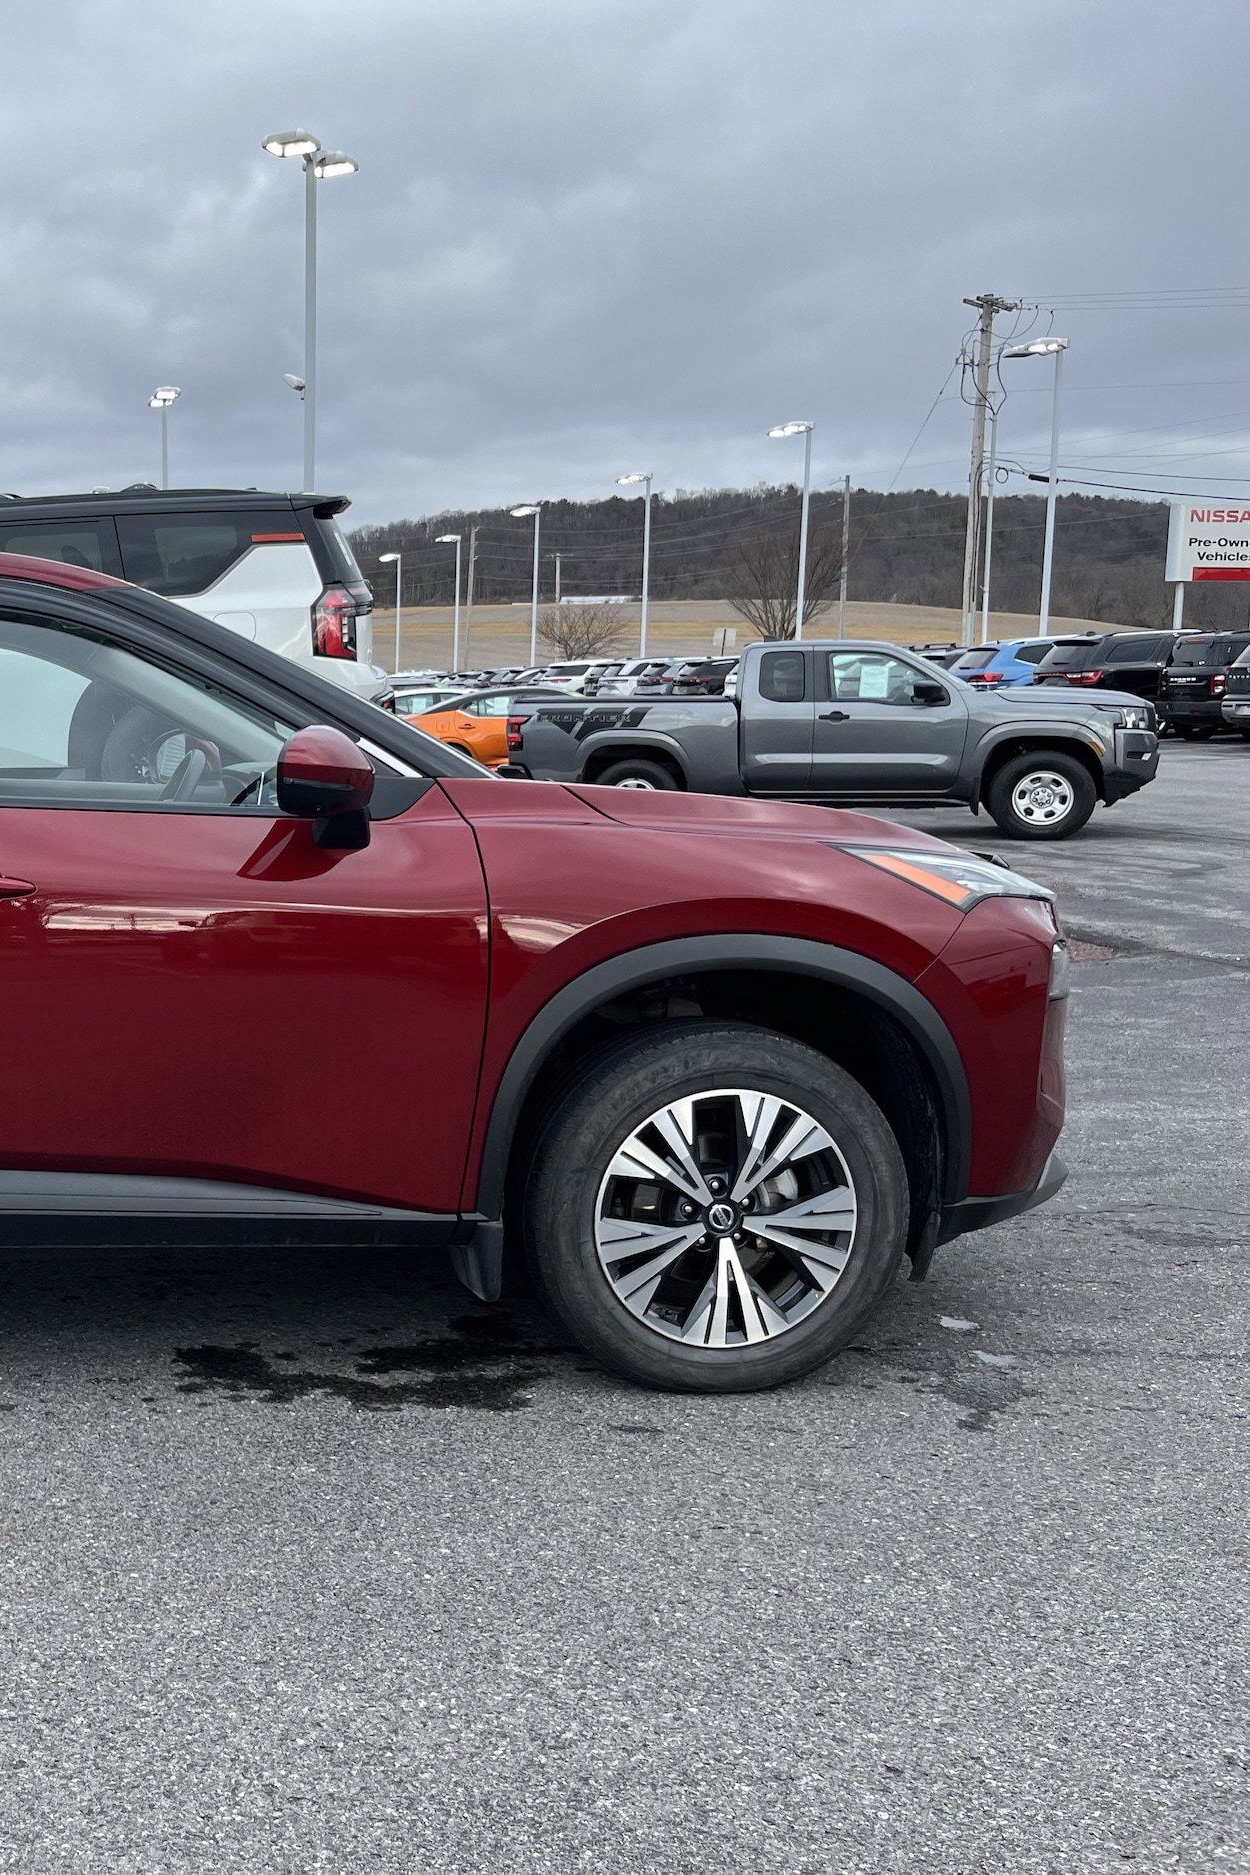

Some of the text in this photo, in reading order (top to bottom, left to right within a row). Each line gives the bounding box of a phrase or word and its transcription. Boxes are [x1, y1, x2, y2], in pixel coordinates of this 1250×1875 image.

[1188, 537, 1250, 547] Pre-Own
[1197, 551, 1250, 561] Vehicle
[536, 713, 631, 722] FRONTIER
